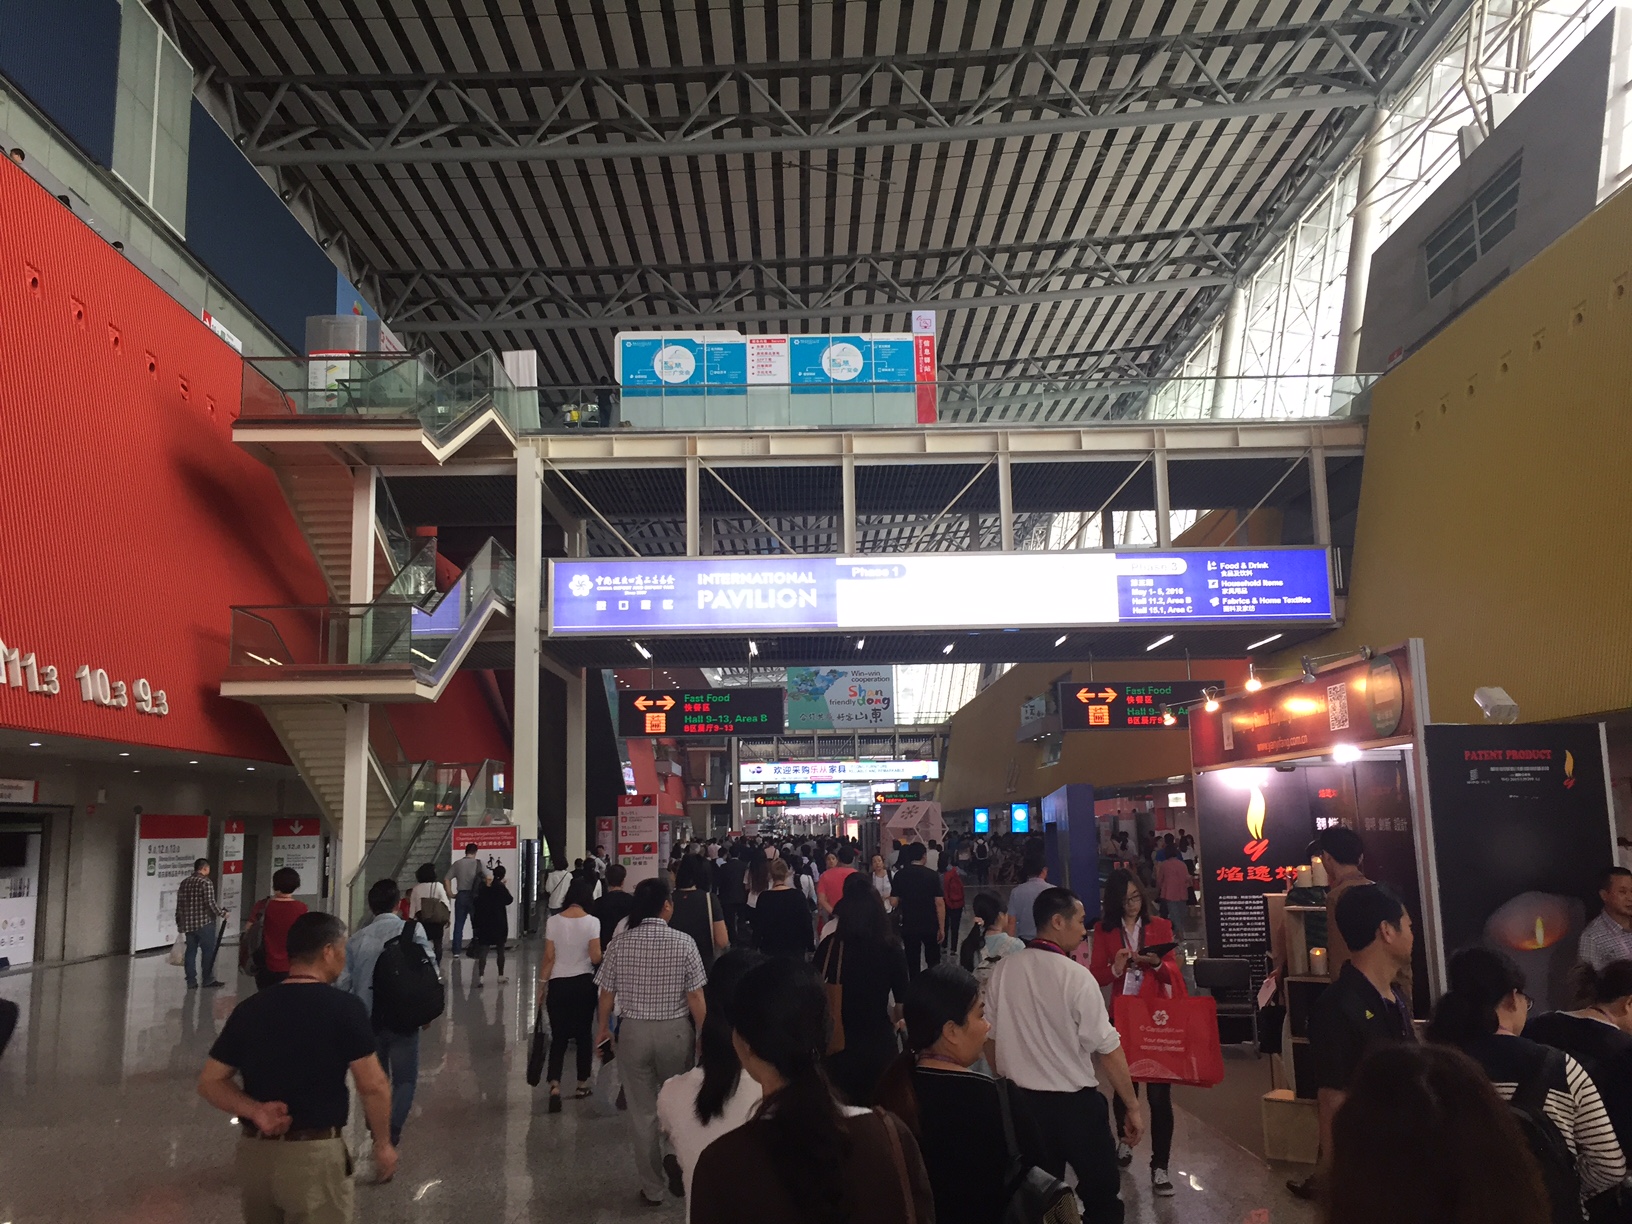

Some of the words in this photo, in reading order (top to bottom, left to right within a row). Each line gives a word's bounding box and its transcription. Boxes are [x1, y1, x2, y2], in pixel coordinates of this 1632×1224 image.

[852, 566, 889, 577] Phase
[892, 566, 899, 577] 1
[1132, 563, 1167, 572] Phase
[1172, 562, 1178, 571] 3
[698, 572, 816, 584] INTERNATIONAL
[1132, 588, 1147, 596] May
[698, 588, 817, 610] PAVILION
[76, 664, 128, 708] 10.3
[132, 678, 168, 715] 9.3
[849, 684, 883, 697] Shan
[1126, 687, 1146, 695] Fast
[1148, 686, 1172, 694] Food
[684, 694, 704, 702] Fast
[707, 694, 730, 702] Food
[857, 696, 890, 710] dong
[1126, 696, 1152, 704] 快餐区
[684, 703, 710, 712] 快餐区
[1127, 708, 1146, 716] Hall
[1148, 707, 1175, 716] 9-3,
[684, 715, 703, 723] Hall
[706, 715, 732, 723] 9-13,
[735, 714, 758, 722] Area
[760, 714, 768, 722] B
[1464, 750, 1502, 760] PATENT
[1506, 750, 1552, 760] PRODUCT
[774, 765, 847, 775] 欢迎采购乐从家具
